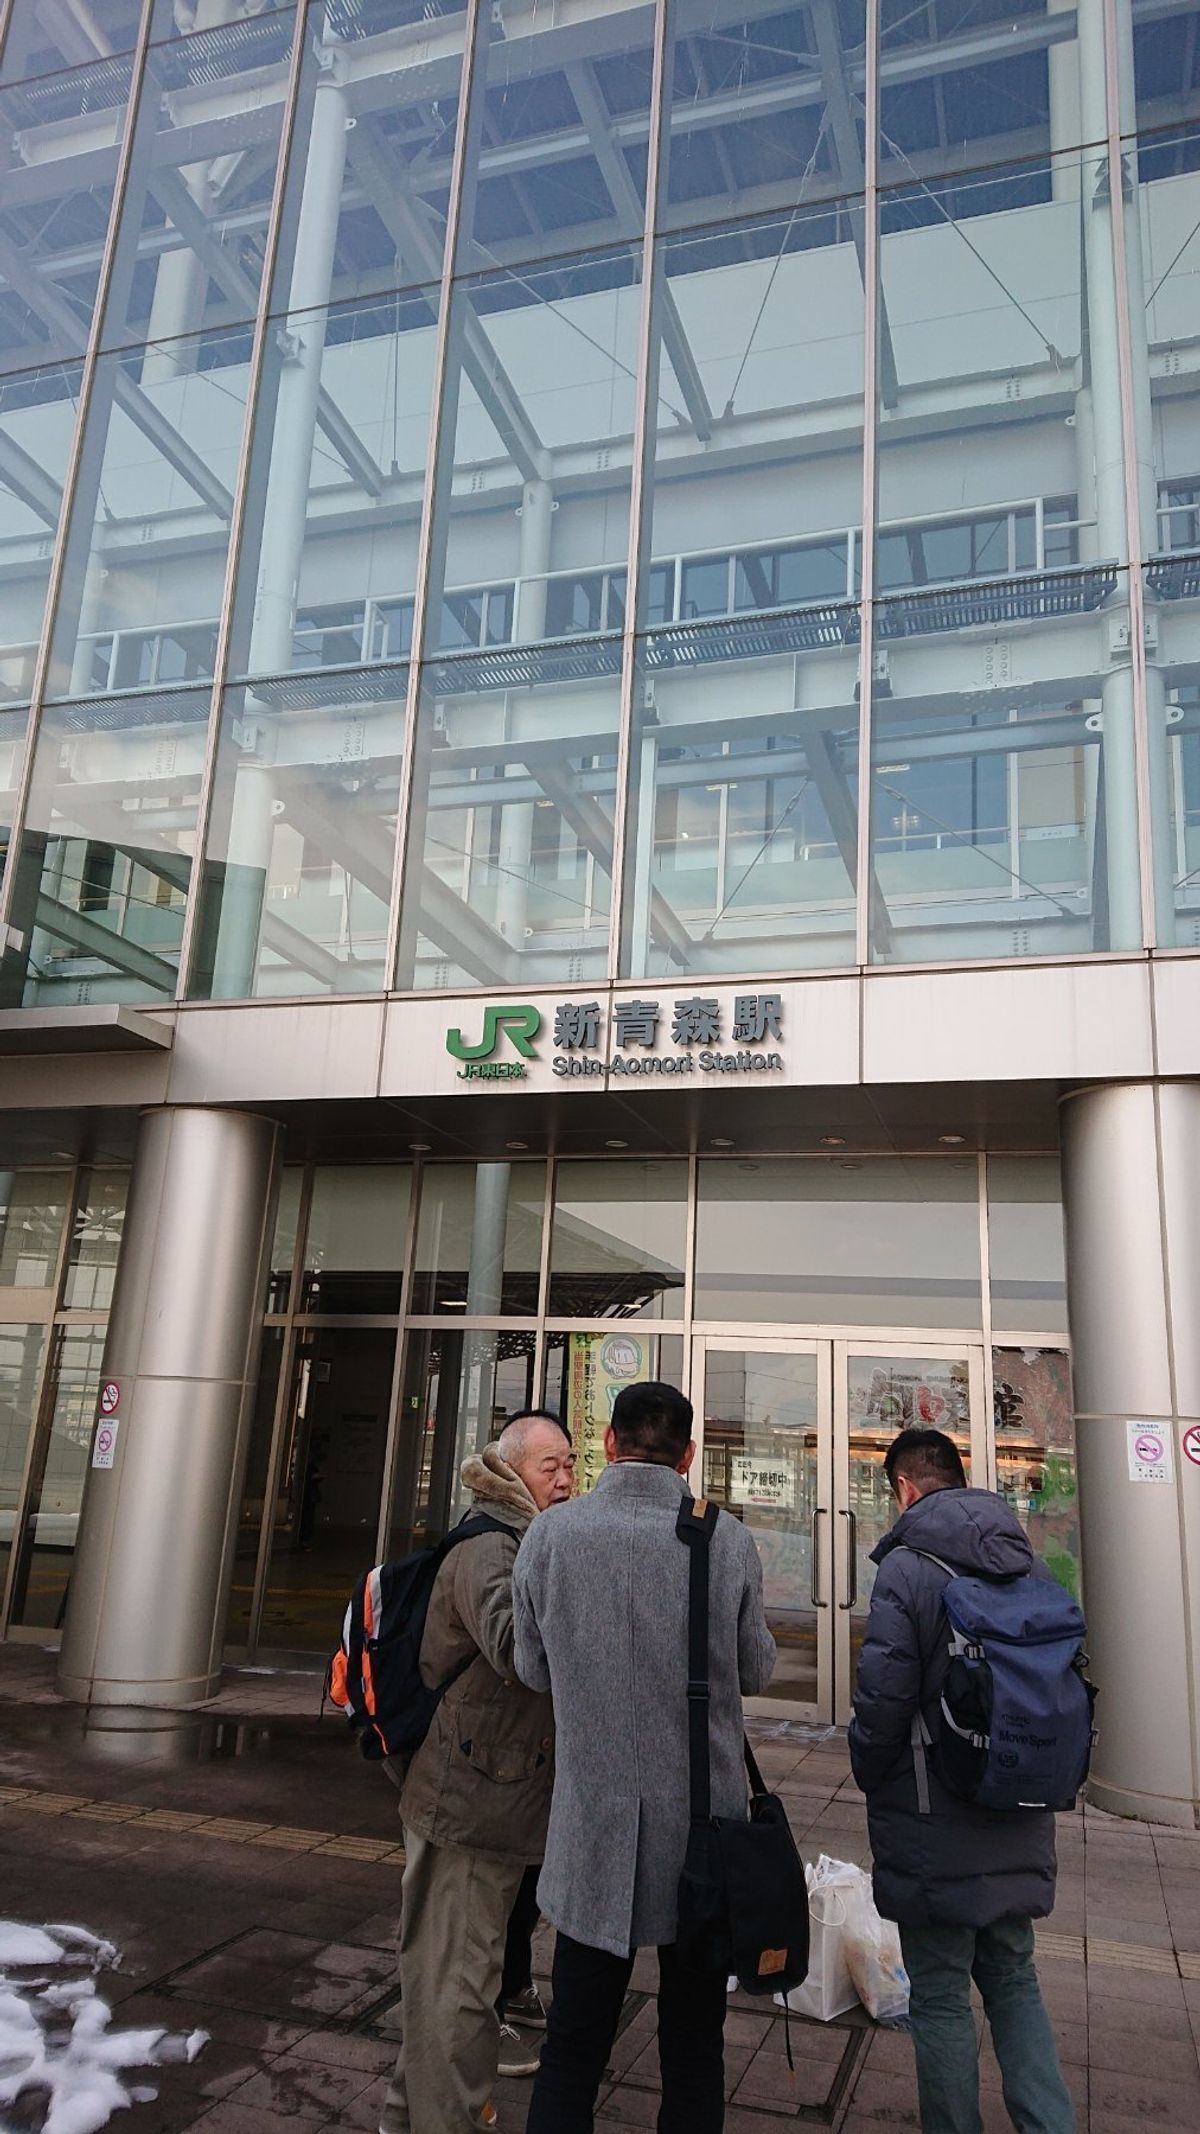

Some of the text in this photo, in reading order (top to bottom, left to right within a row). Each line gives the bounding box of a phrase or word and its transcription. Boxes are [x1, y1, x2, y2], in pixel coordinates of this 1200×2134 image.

[446, 1004, 541, 1060] JR
[553, 993, 784, 1049] 新青森駅
[456, 1062, 527, 1080] JR東日本
[552, 1050, 782, 1077] Shin-Aomori Station
